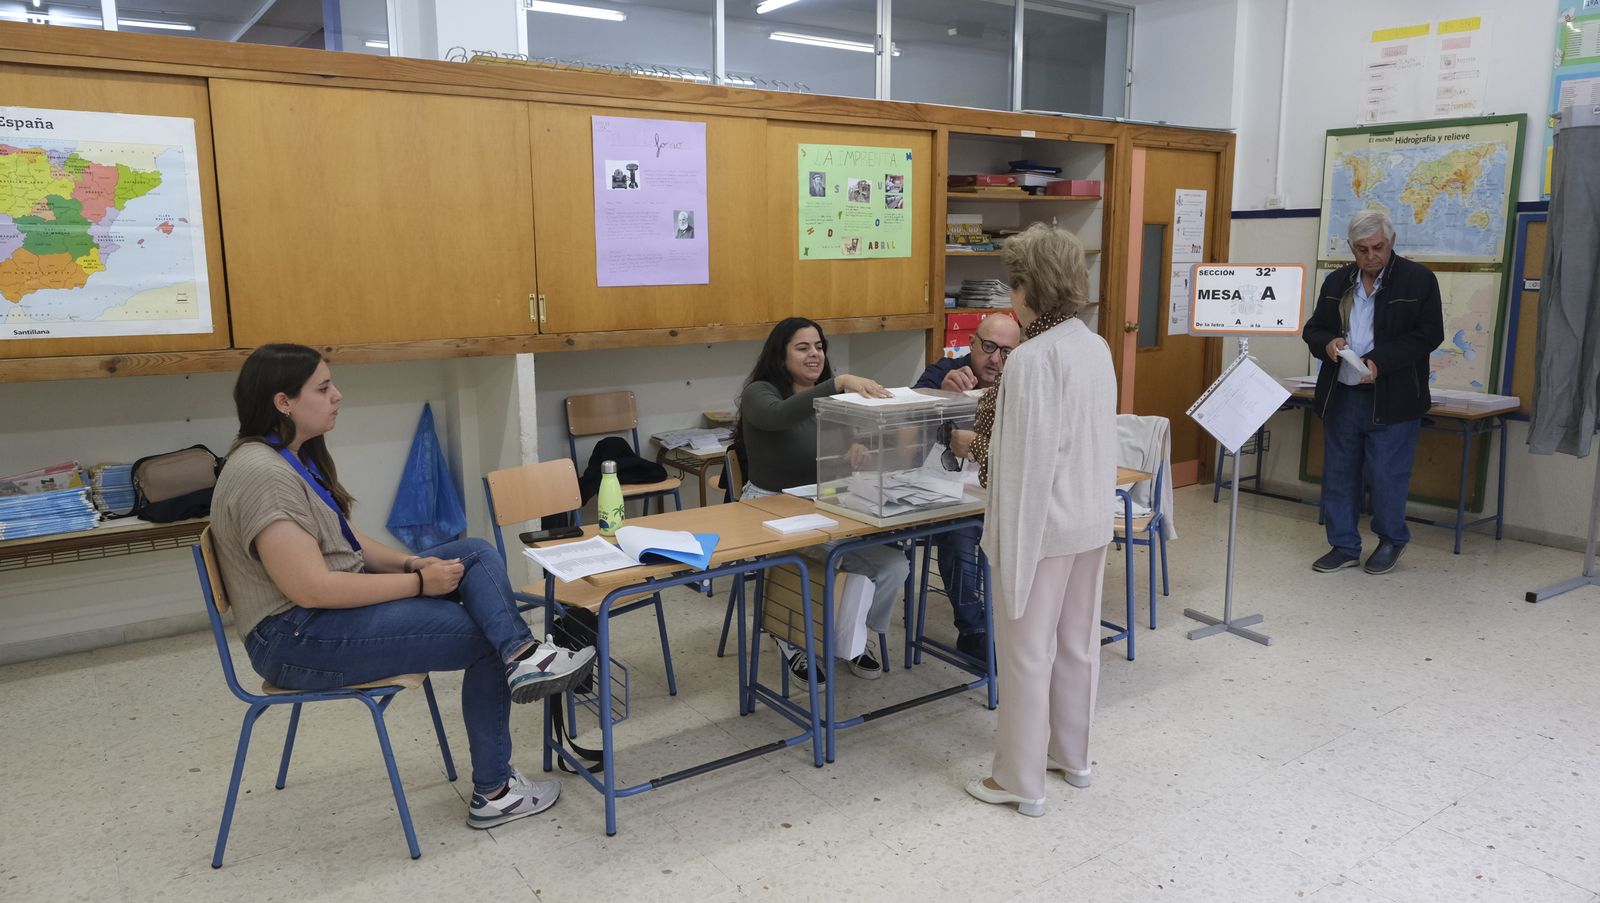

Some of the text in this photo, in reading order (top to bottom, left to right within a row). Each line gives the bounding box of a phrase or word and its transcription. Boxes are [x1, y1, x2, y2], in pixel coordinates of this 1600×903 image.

[1437, 135, 1443, 143] y
[1444, 132, 1470, 142] relieve
[1198, 286, 1276, 300] MESA A
